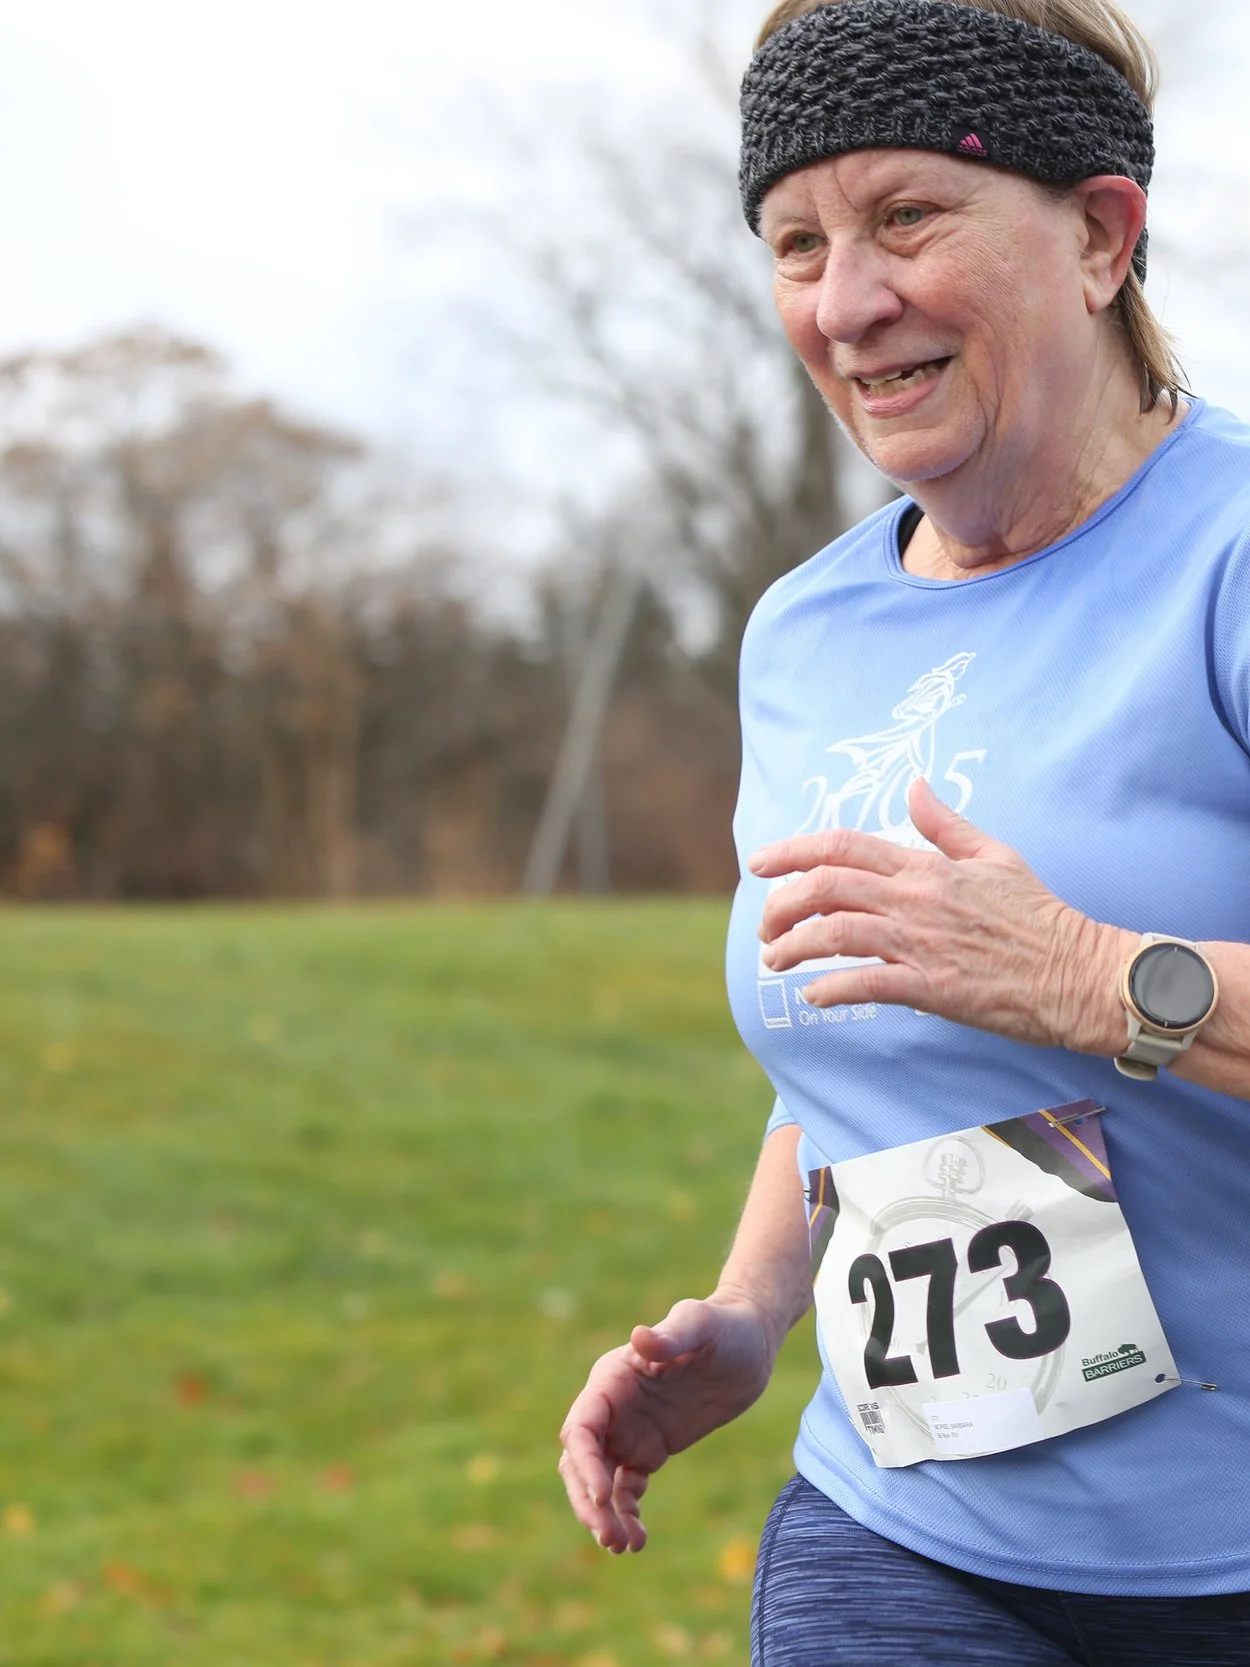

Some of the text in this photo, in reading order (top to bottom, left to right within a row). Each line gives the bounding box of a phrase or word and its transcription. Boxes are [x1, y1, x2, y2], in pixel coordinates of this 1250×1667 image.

[800, 1010, 818, 1026] On
[820, 1008, 850, 1023] Your
[848, 1220, 1071, 1390] 273
[1081, 1351, 1119, 1367] Buffalo
[1084, 1354, 1144, 1380] BARRIERS
